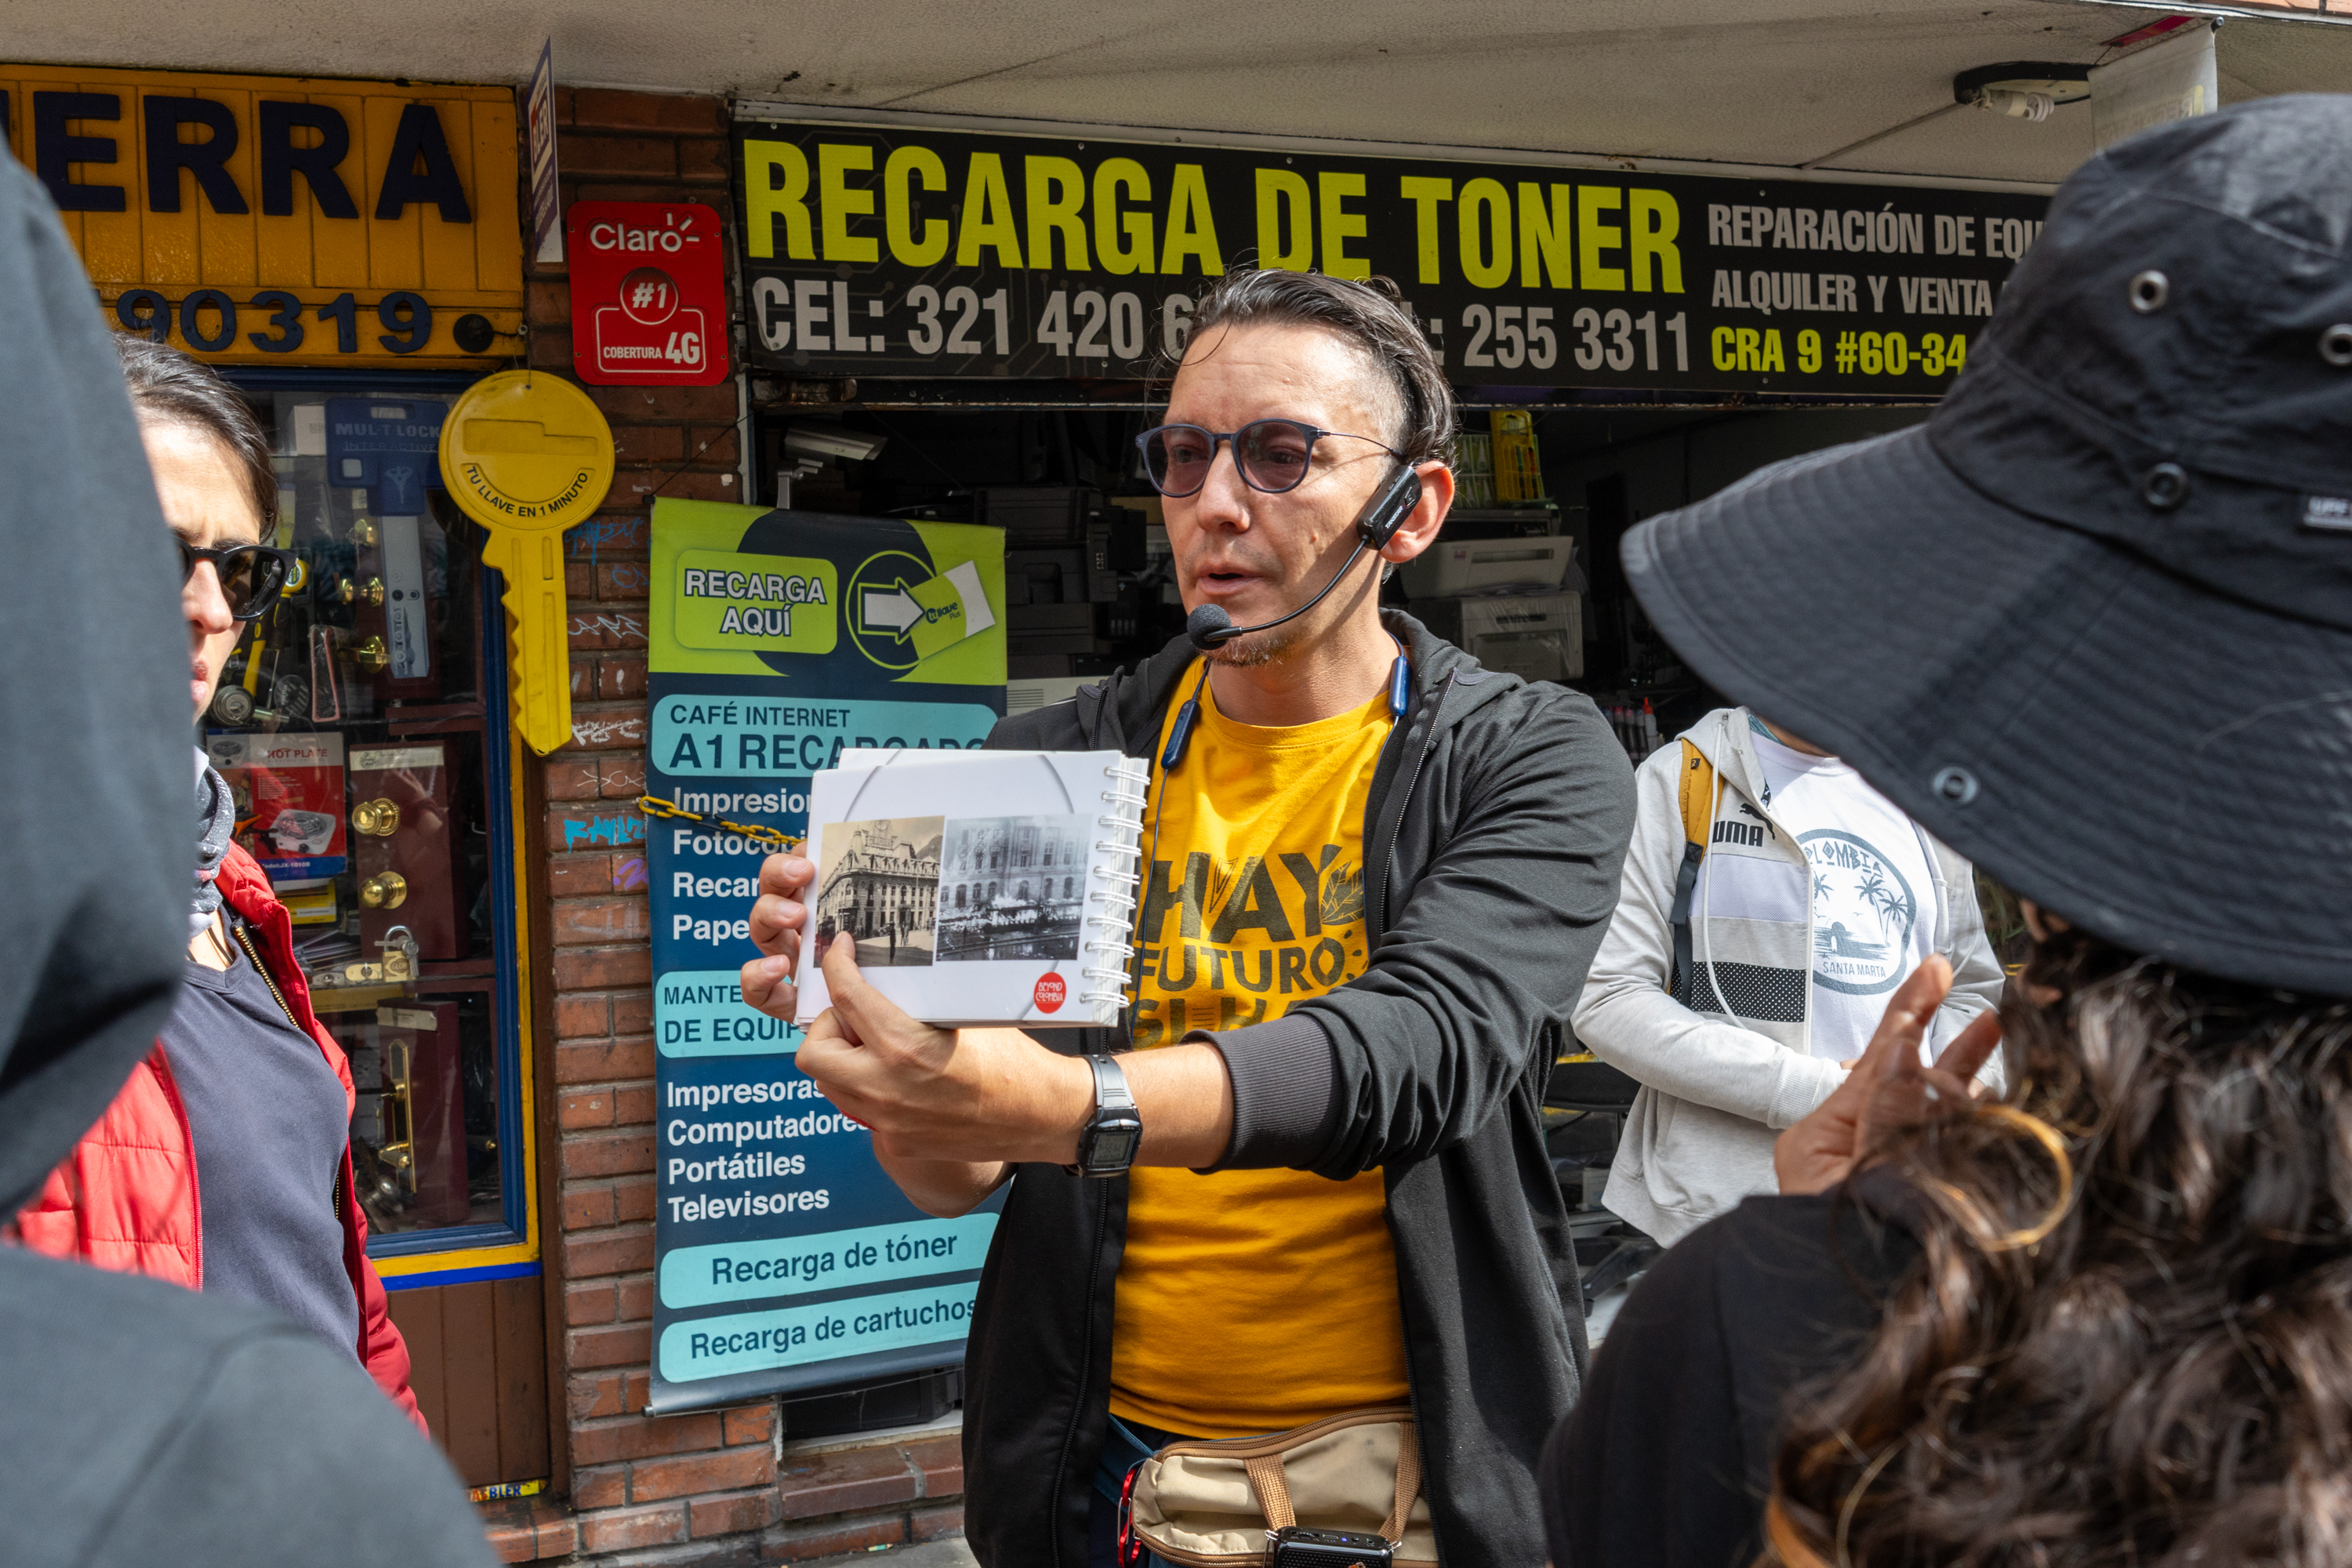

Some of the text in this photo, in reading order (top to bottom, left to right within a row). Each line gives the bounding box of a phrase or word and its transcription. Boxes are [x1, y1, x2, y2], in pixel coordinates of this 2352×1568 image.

[0, 89, 472, 223] ERRA
[744, 139, 1685, 294] RECARGA DE TONER
[1708, 201, 1924, 255] REPARACIÓN
[1934, 214, 1976, 257] DE
[590, 222, 682, 252] Claro
[632, 282, 667, 309] #1
[1711, 269, 1994, 317] ALQUILER Y VENTA
[94, 289, 432, 354] 90319
[753, 277, 1212, 361] CEL: 321 420 6
[1461, 303, 1557, 370] 255
[1572, 307, 1689, 372] 3311
[603, 332, 700, 365] COBERTURA 4G
[1711, 325, 1967, 377] CRA 9 #60-34
[466, 466, 588, 517] TU LLAVE EN 1 MINUTO
[684, 568, 828, 605] RECARGA
[719, 603, 792, 637] AQUÍ
[670, 701, 851, 728] CAFÉ INTERNET
[670, 732, 723, 769] A1
[1712, 820, 1764, 848] UMA
[1804, 840, 1884, 878] OLOMBIA
[1135, 844, 1343, 944] HAY
[673, 914, 750, 946] Pape
[1127, 937, 1345, 994] FUTURO
[1823, 961, 1886, 978] SANTA MARTA
[664, 985, 742, 1005] MANTE
[1035, 992, 1064, 1002] COLOMBIA
[1038, 982, 1063, 992] BEYOND
[664, 1019, 702, 1044] DE
[667, 1110, 872, 1148] Computadore
[668, 1151, 806, 1185] Portátiles
[668, 1188, 829, 1223] Televisores
[712, 1234, 958, 1285] Recarga de tóner
[691, 1323, 806, 1359] Recarga
[815, 1316, 846, 1341] de
